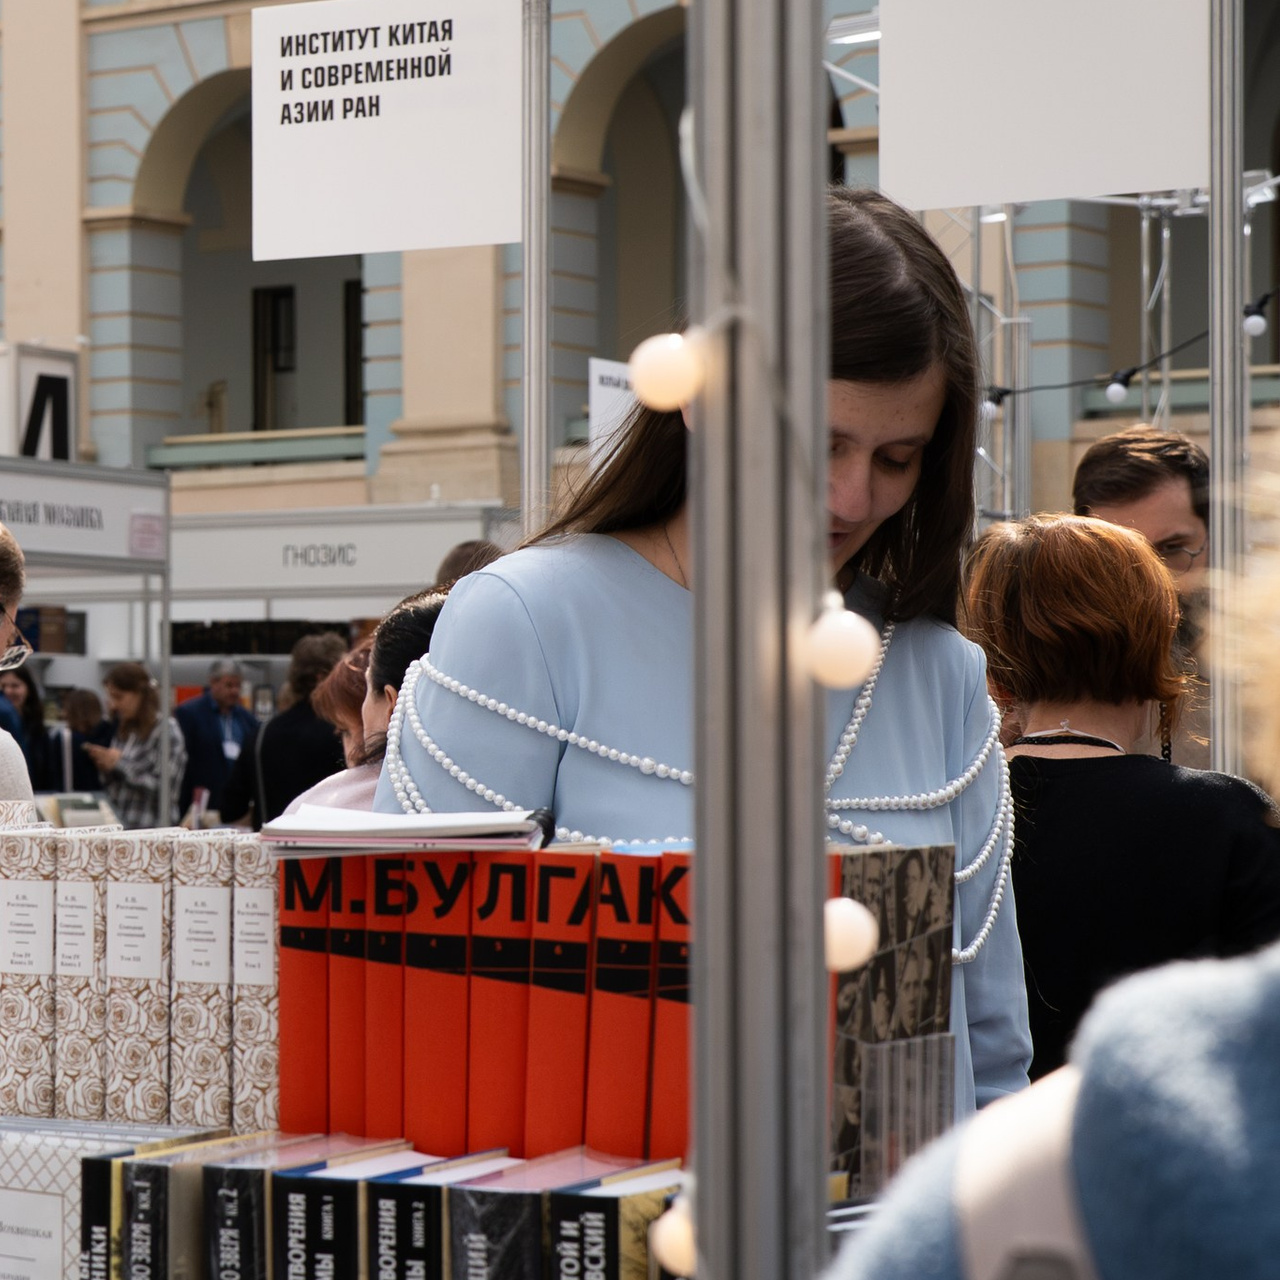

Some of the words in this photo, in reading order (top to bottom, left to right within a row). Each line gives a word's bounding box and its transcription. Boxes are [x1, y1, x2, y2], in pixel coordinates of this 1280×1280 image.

[280, 26, 381, 58] ИНСТИТУТ
[388, 18, 453, 47] КИТАЯ
[280, 69, 293, 91] И
[301, 47, 452, 89] СОВРЕМЕННОЙ
[280, 99, 334, 125] АЗИИ
[342, 95, 380, 120] РАН
[282, 542, 357, 568] ГНОЗИС
[131, 1223, 151, 1263] ЗВЕРЯ
[219, 1228, 239, 1268] ЗВЕРЯ
[560, 1220, 579, 1237] И
